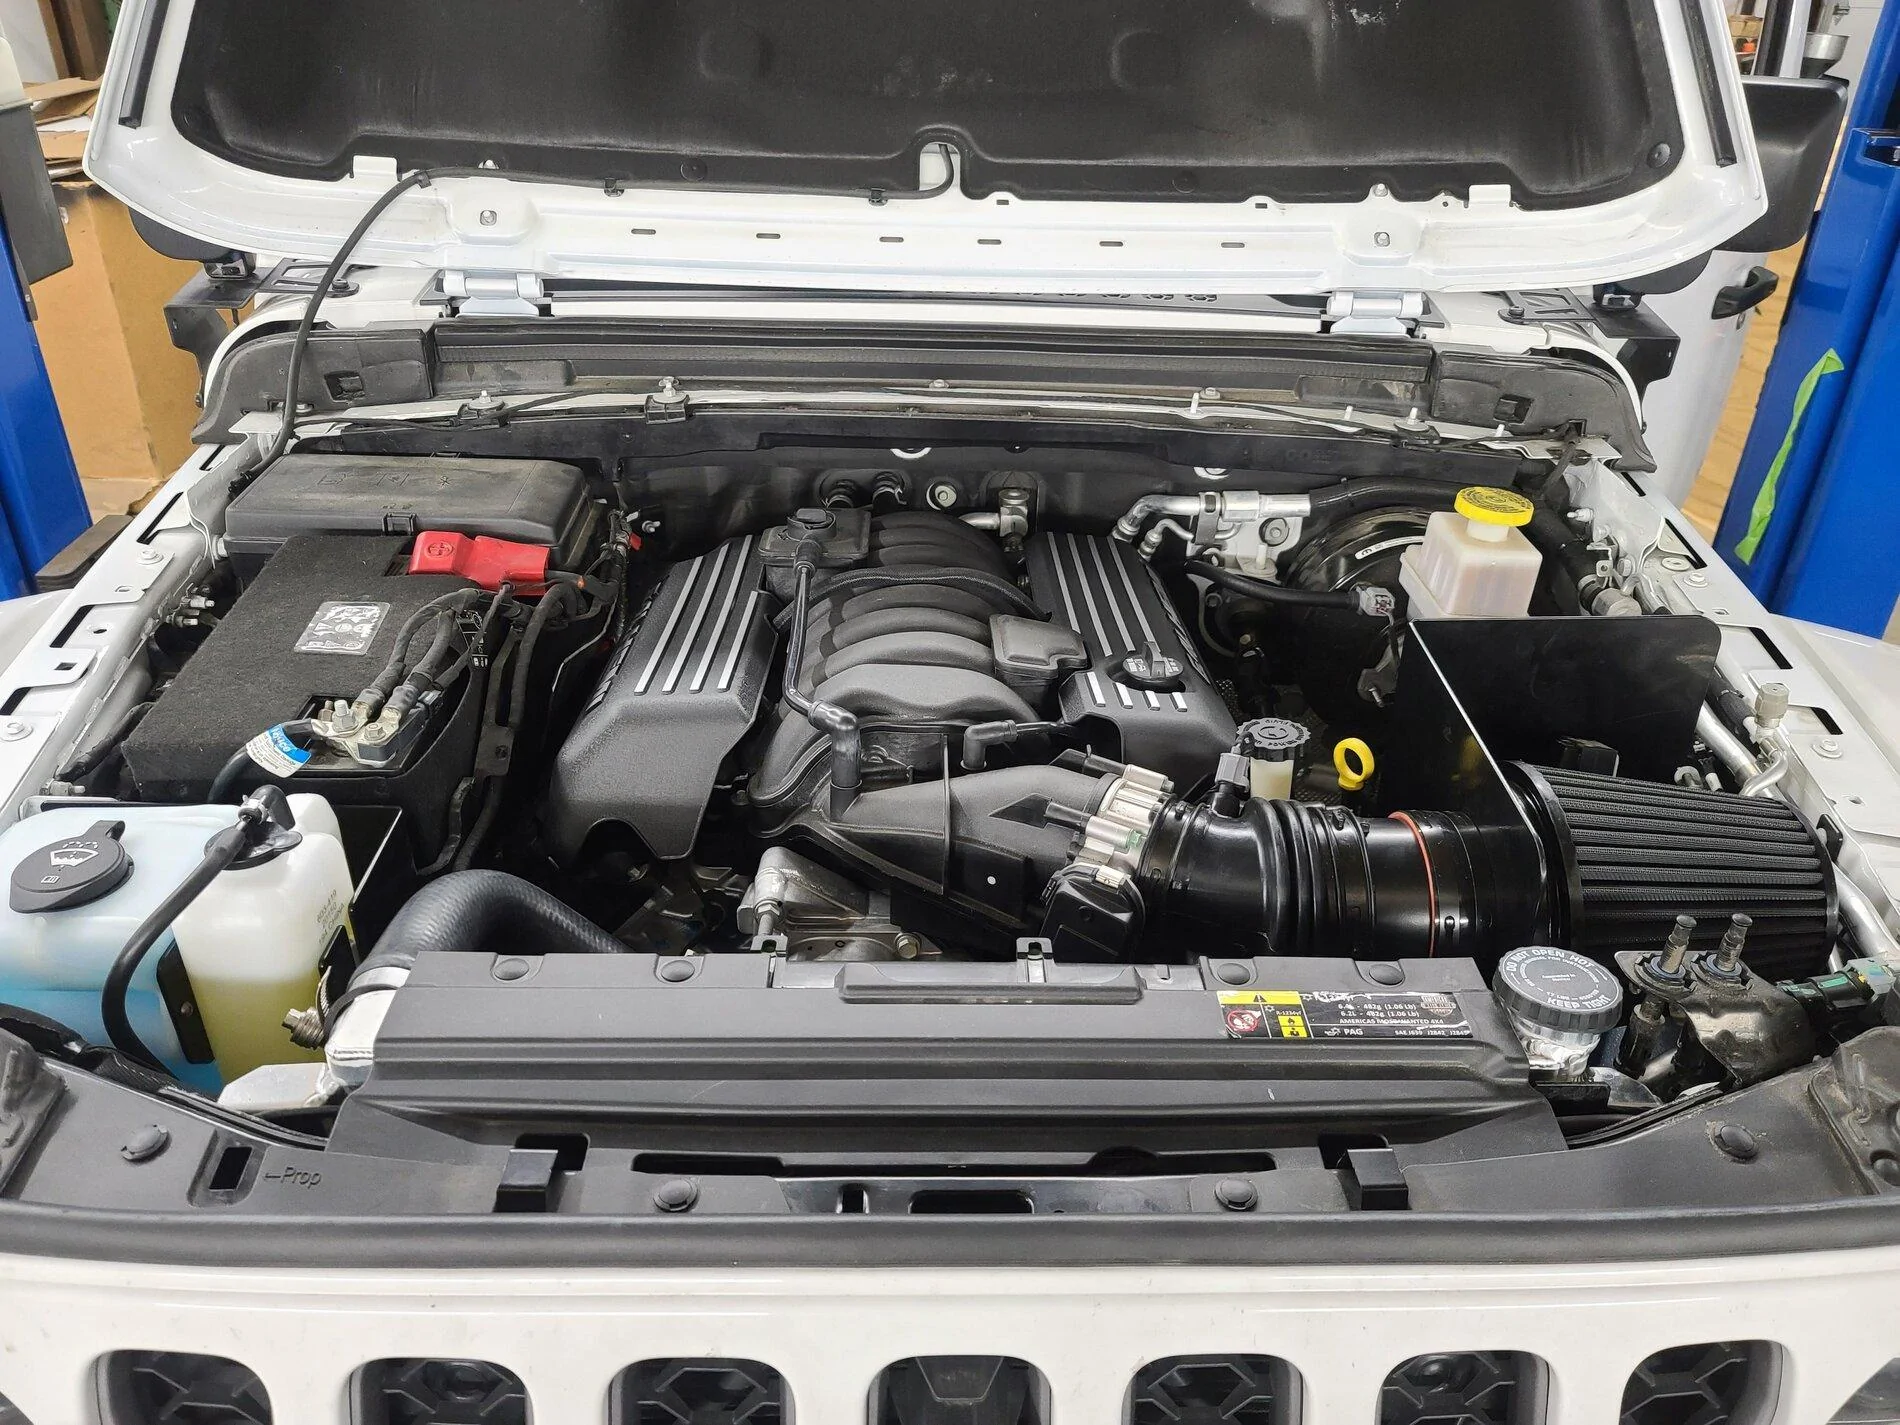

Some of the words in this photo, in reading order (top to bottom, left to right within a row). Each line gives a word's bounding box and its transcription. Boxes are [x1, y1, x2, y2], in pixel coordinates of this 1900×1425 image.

[1510, 951, 1529, 962] NOT
[1531, 949, 1565, 958] OPEN
[1569, 955, 1594, 968] HOT
[1547, 997, 1580, 1009] KEEP
[1582, 994, 1611, 1009] TIGHT
[1343, 1028, 1364, 1036] PAG
[280, 1166, 322, 1189] Prop
